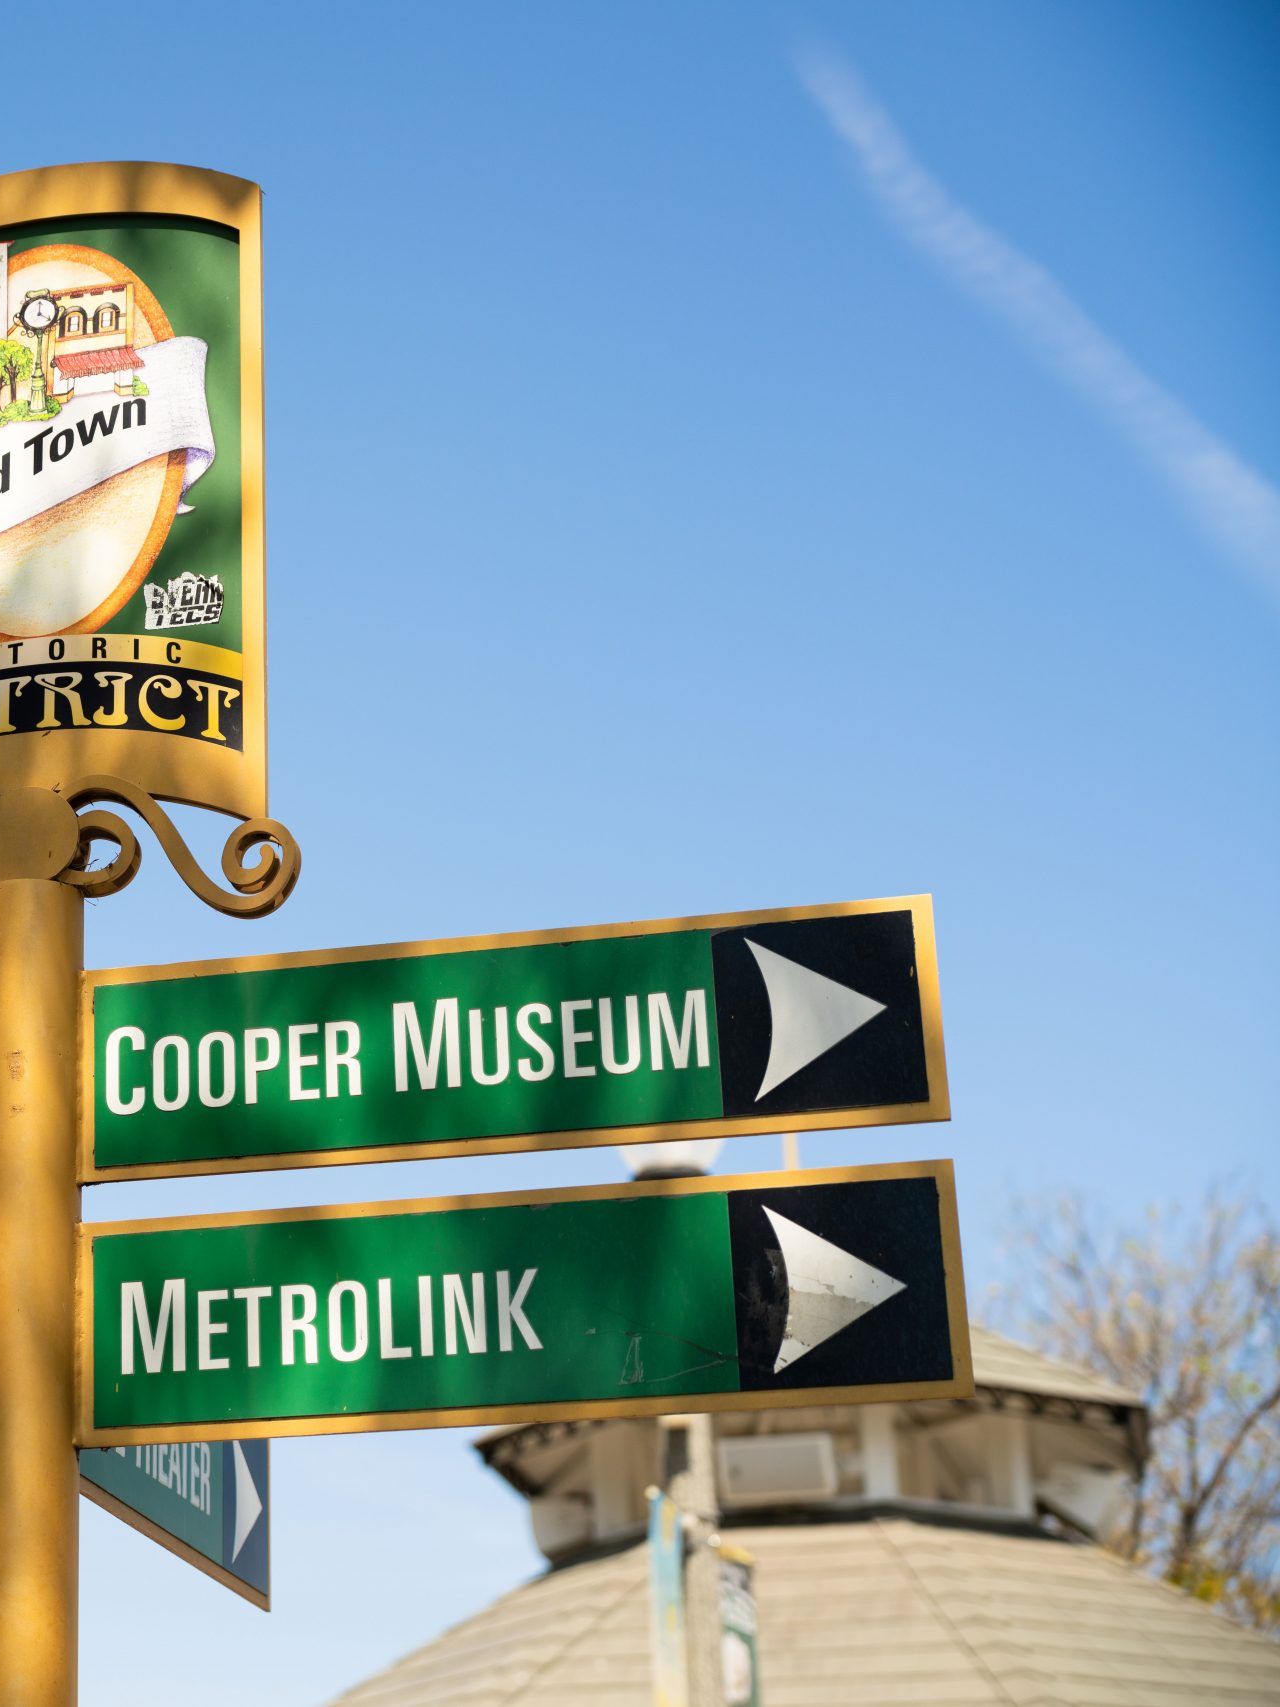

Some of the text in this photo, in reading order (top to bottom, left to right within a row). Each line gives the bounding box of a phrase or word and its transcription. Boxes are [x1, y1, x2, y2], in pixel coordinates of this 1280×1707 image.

[23, 397, 148, 476] Town
[104, 988, 711, 1117] COOPER MUSEUM
[120, 1267, 545, 1376] METROLINK
